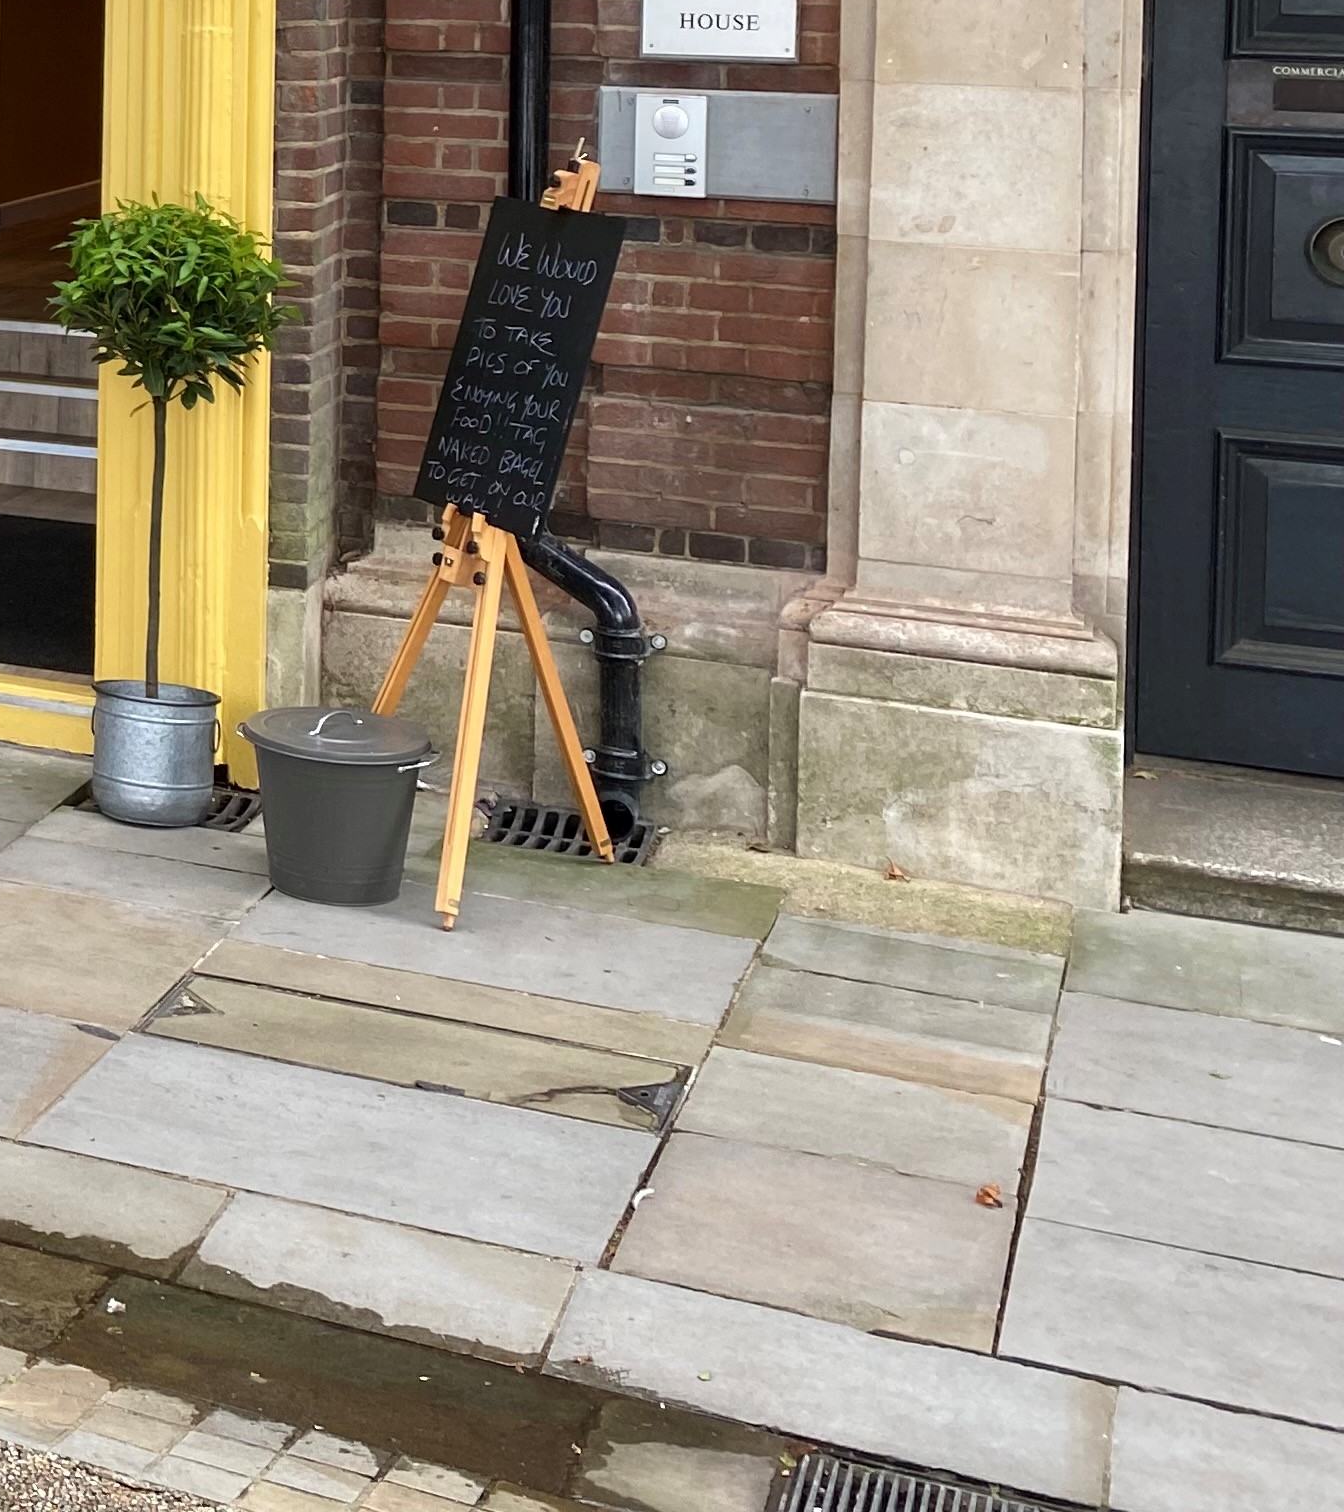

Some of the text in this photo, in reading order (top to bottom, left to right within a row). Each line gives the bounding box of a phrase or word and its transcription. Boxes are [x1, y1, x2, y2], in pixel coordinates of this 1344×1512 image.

[679, 12, 760, 32] HOUSE
[497, 232, 597, 286] WE WOULD
[487, 279, 572, 319] LOVE YOU
[474, 318, 557, 357] TO TAKE
[465, 347, 568, 389] PICS OF YOU
[521, 394, 561, 423] YOUR
[509, 422, 547, 454] TAG
[438, 436, 543, 485] NAKED BAGEL
[427, 461, 546, 512] TO GET ON OUR
